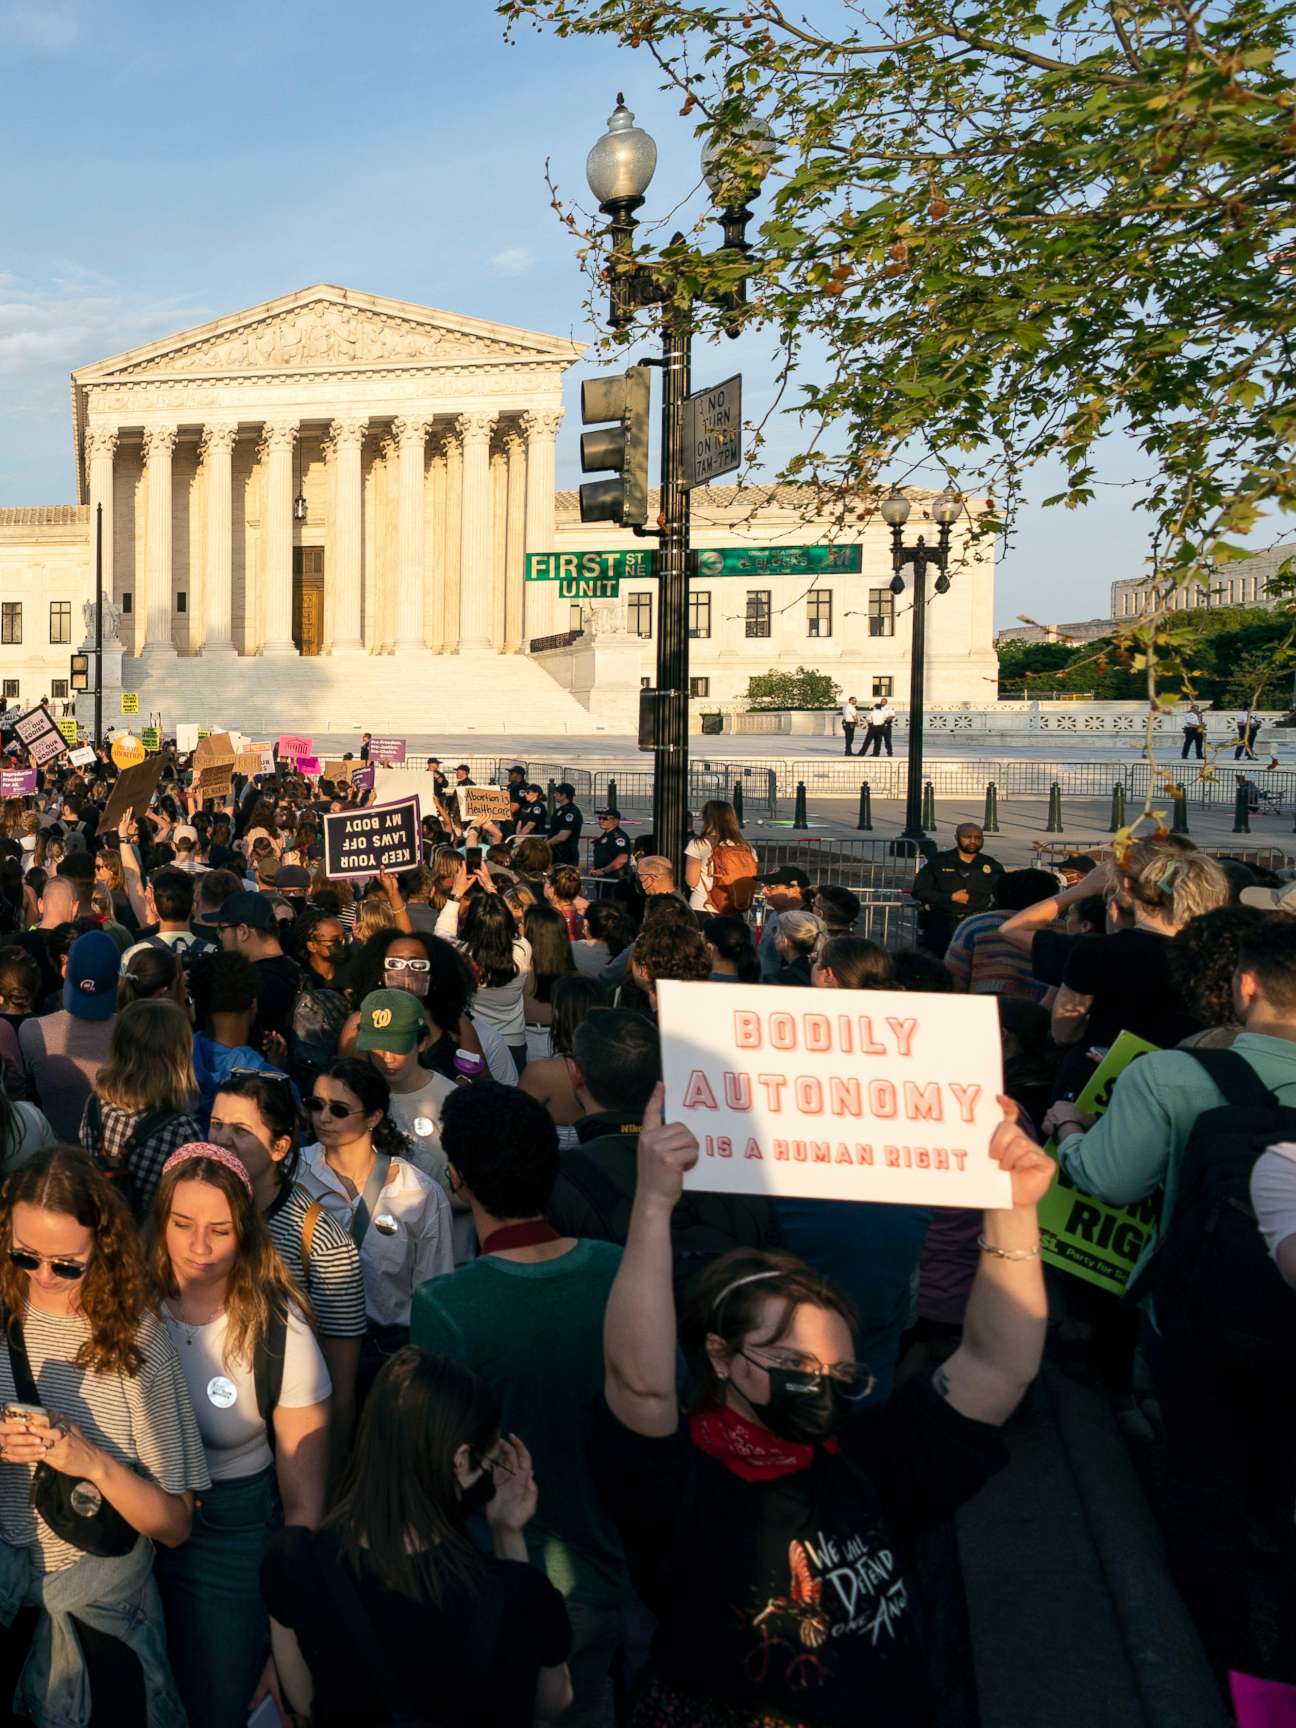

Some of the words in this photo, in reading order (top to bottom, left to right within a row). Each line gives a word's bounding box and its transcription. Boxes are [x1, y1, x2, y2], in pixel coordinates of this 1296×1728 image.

[708, 391, 725, 413] NO
[704, 408, 731, 434] TURN
[697, 437, 711, 457] ON
[696, 449, 738, 477] 7AM-7PM
[530, 553, 621, 578] FIRST
[625, 553, 645, 564] ST
[625, 564, 646, 576] NE
[563, 580, 617, 596] UNIT
[32, 718, 44, 729] OUR
[25, 726, 45, 740] BODIES
[45, 739, 58, 750] OUR
[38, 746, 59, 761] BODIES
[466, 790, 499, 803] Abortion
[501, 795, 510, 805] is
[467, 802, 511, 817] Healthcare
[345, 817, 380, 832] BODY
[385, 813, 402, 827] MY
[342, 836, 367, 850] OFF
[372, 830, 406, 847] LAWS
[340, 854, 377, 868] YOUR
[381, 848, 411, 864] KEEP
[733, 1010, 919, 1057] BODILY
[682, 1070, 983, 1123] AUTONOMY
[705, 1135, 733, 1158] IS
[744, 1137, 765, 1160] A
[773, 1138, 875, 1166] HUMAN
[884, 1144, 969, 1172] RIGHT
[1065, 1200, 1152, 1264] RIG
[1067, 1248, 1096, 1267] Party
[1097, 1262, 1115, 1275] for
[804, 1530, 840, 1569] WE
[825, 1550, 894, 1618] DEFEND
